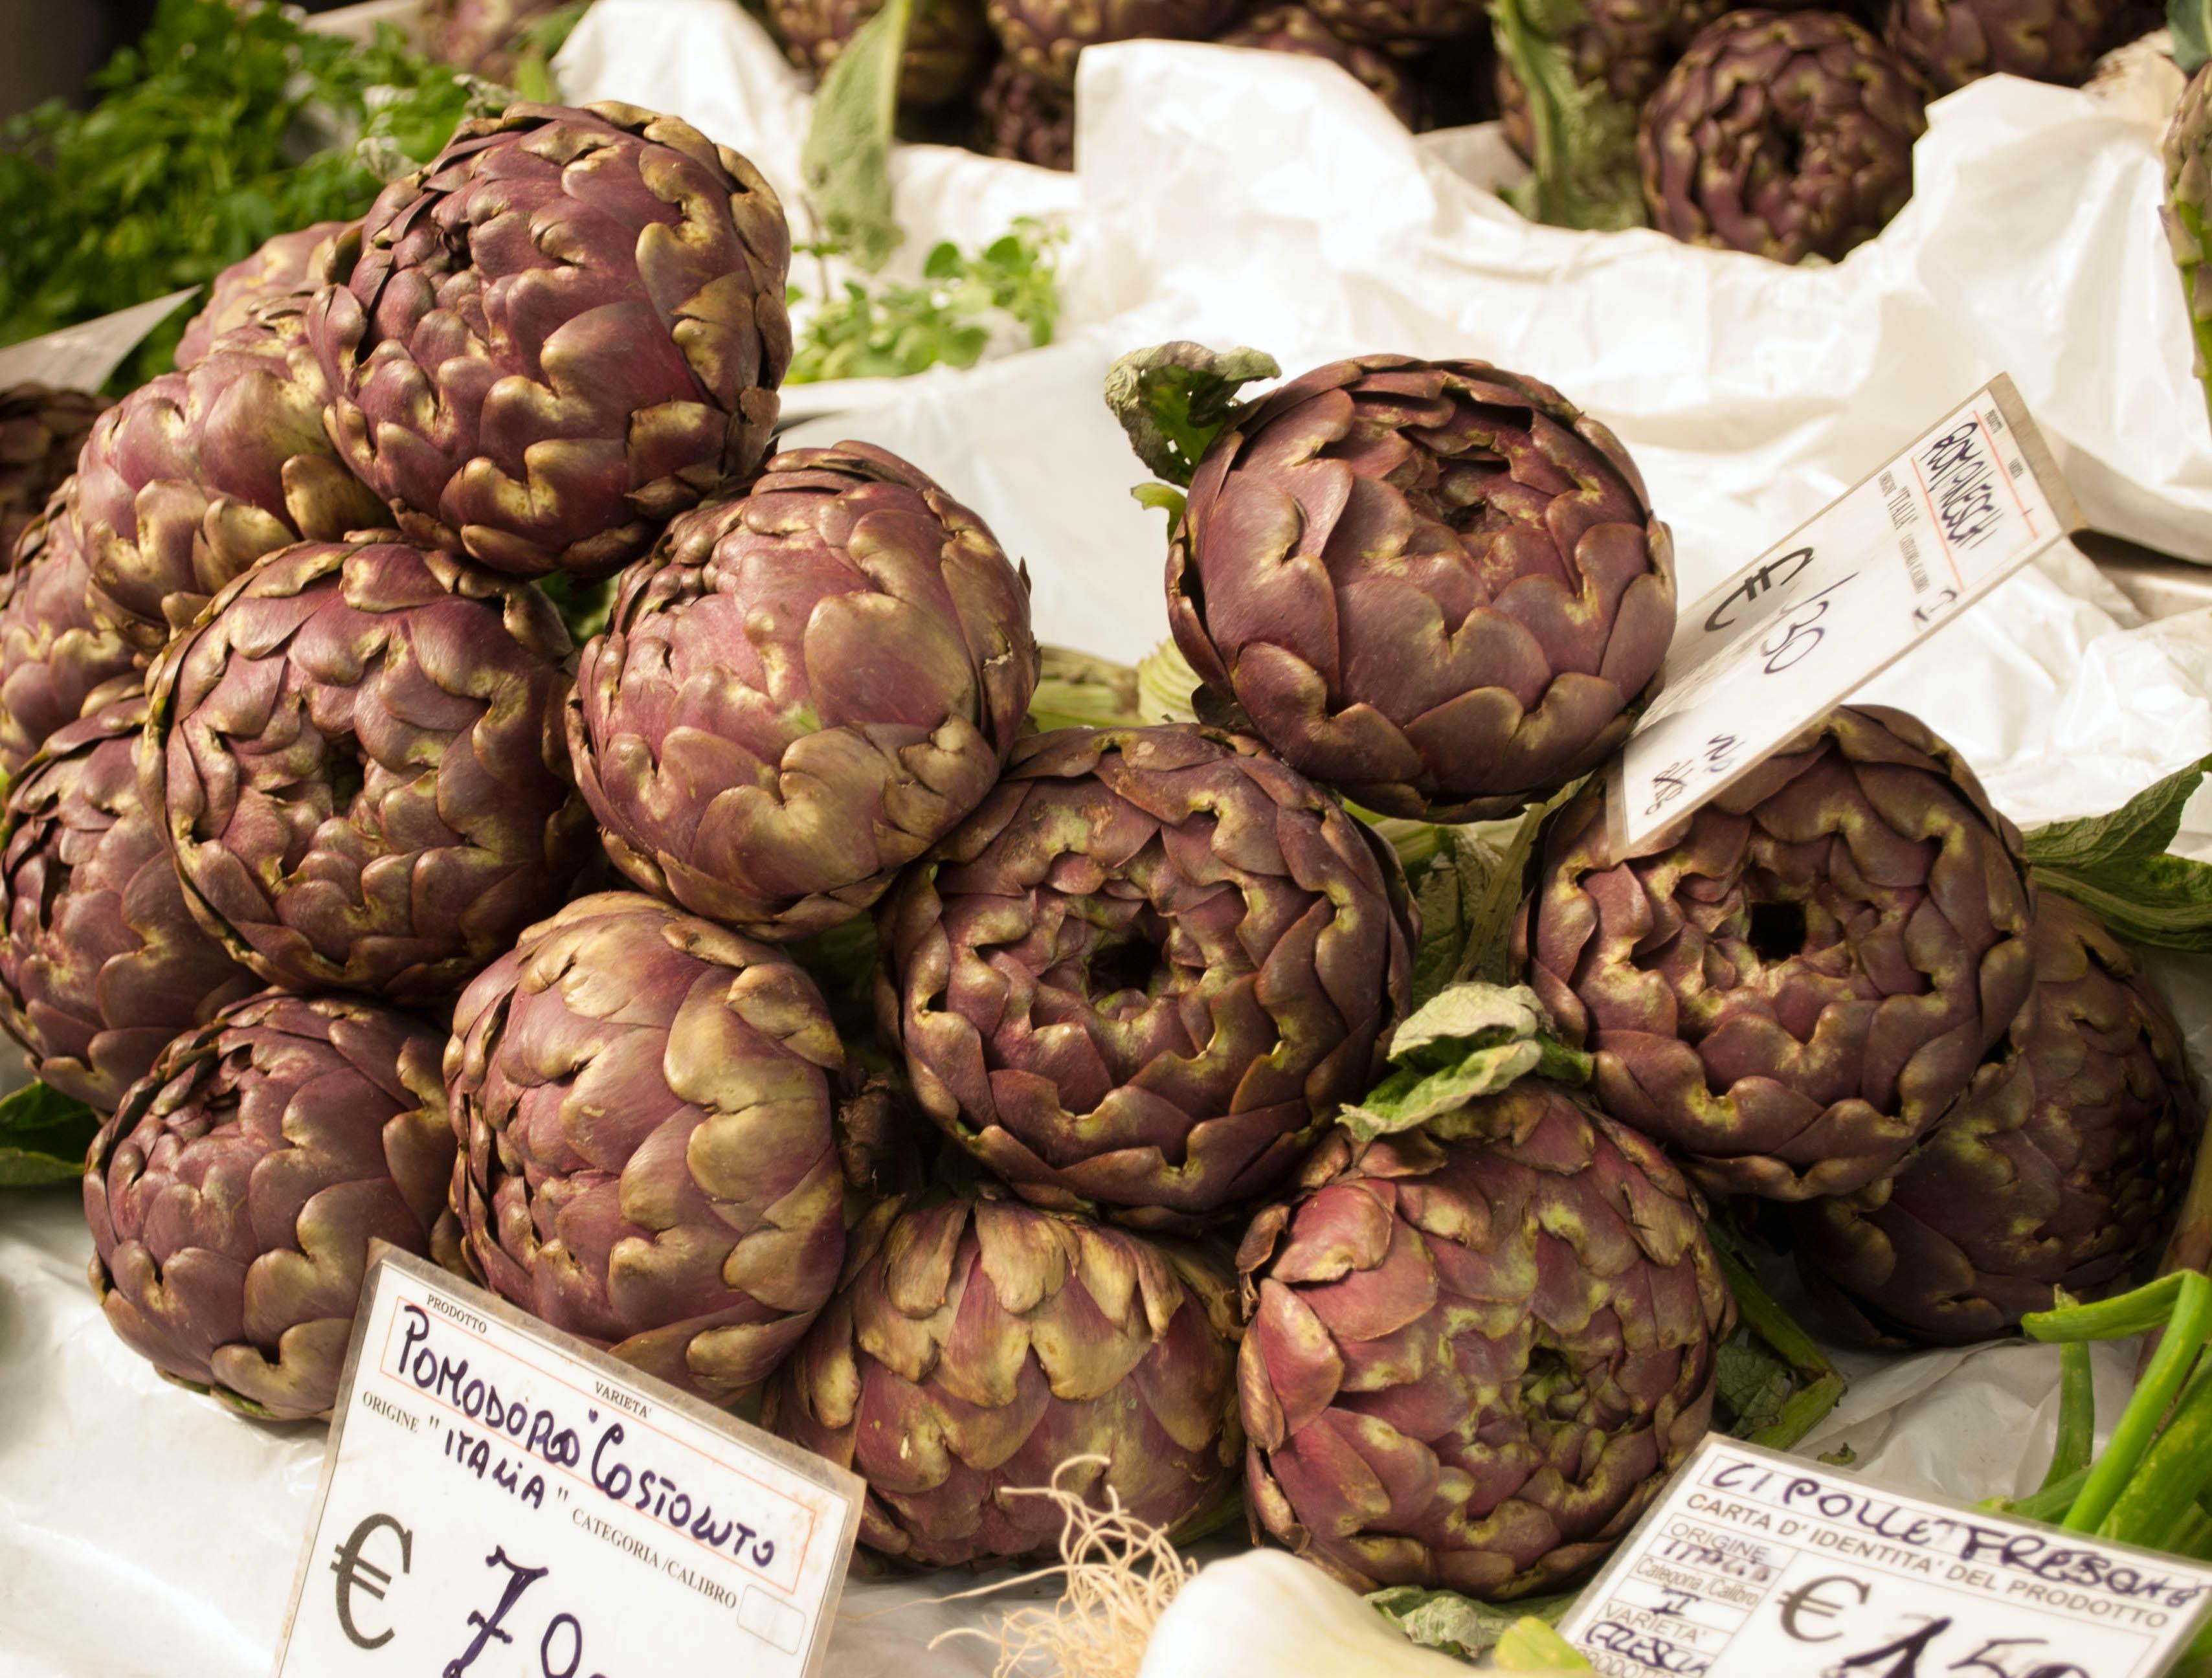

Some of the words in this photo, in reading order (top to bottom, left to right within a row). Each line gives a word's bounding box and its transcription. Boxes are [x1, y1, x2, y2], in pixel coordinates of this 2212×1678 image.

[399, 1304, 581, 1468] POMODORO
[426, 1294, 487, 1334] PRODOTTO
[594, 1381, 653, 1419] VARIETA'
[363, 1391, 419, 1433] ORIGINE
[572, 1508, 659, 1569] CATEGORIA
[1670, 1521, 1771, 1560] ORIGINE
[1686, 1492, 1772, 1530] CARTA
[1778, 1519, 1808, 1537] D'
[1809, 1528, 1943, 1574] IDENTITA'
[1945, 1563, 1998, 1591] DEL
[2005, 1578, 2169, 1628] PRODOTTO
[329, 1512, 413, 1651] €
[1776, 1574, 1872, 1643] €
[1605, 1602, 1708, 1644] VARIETA'
